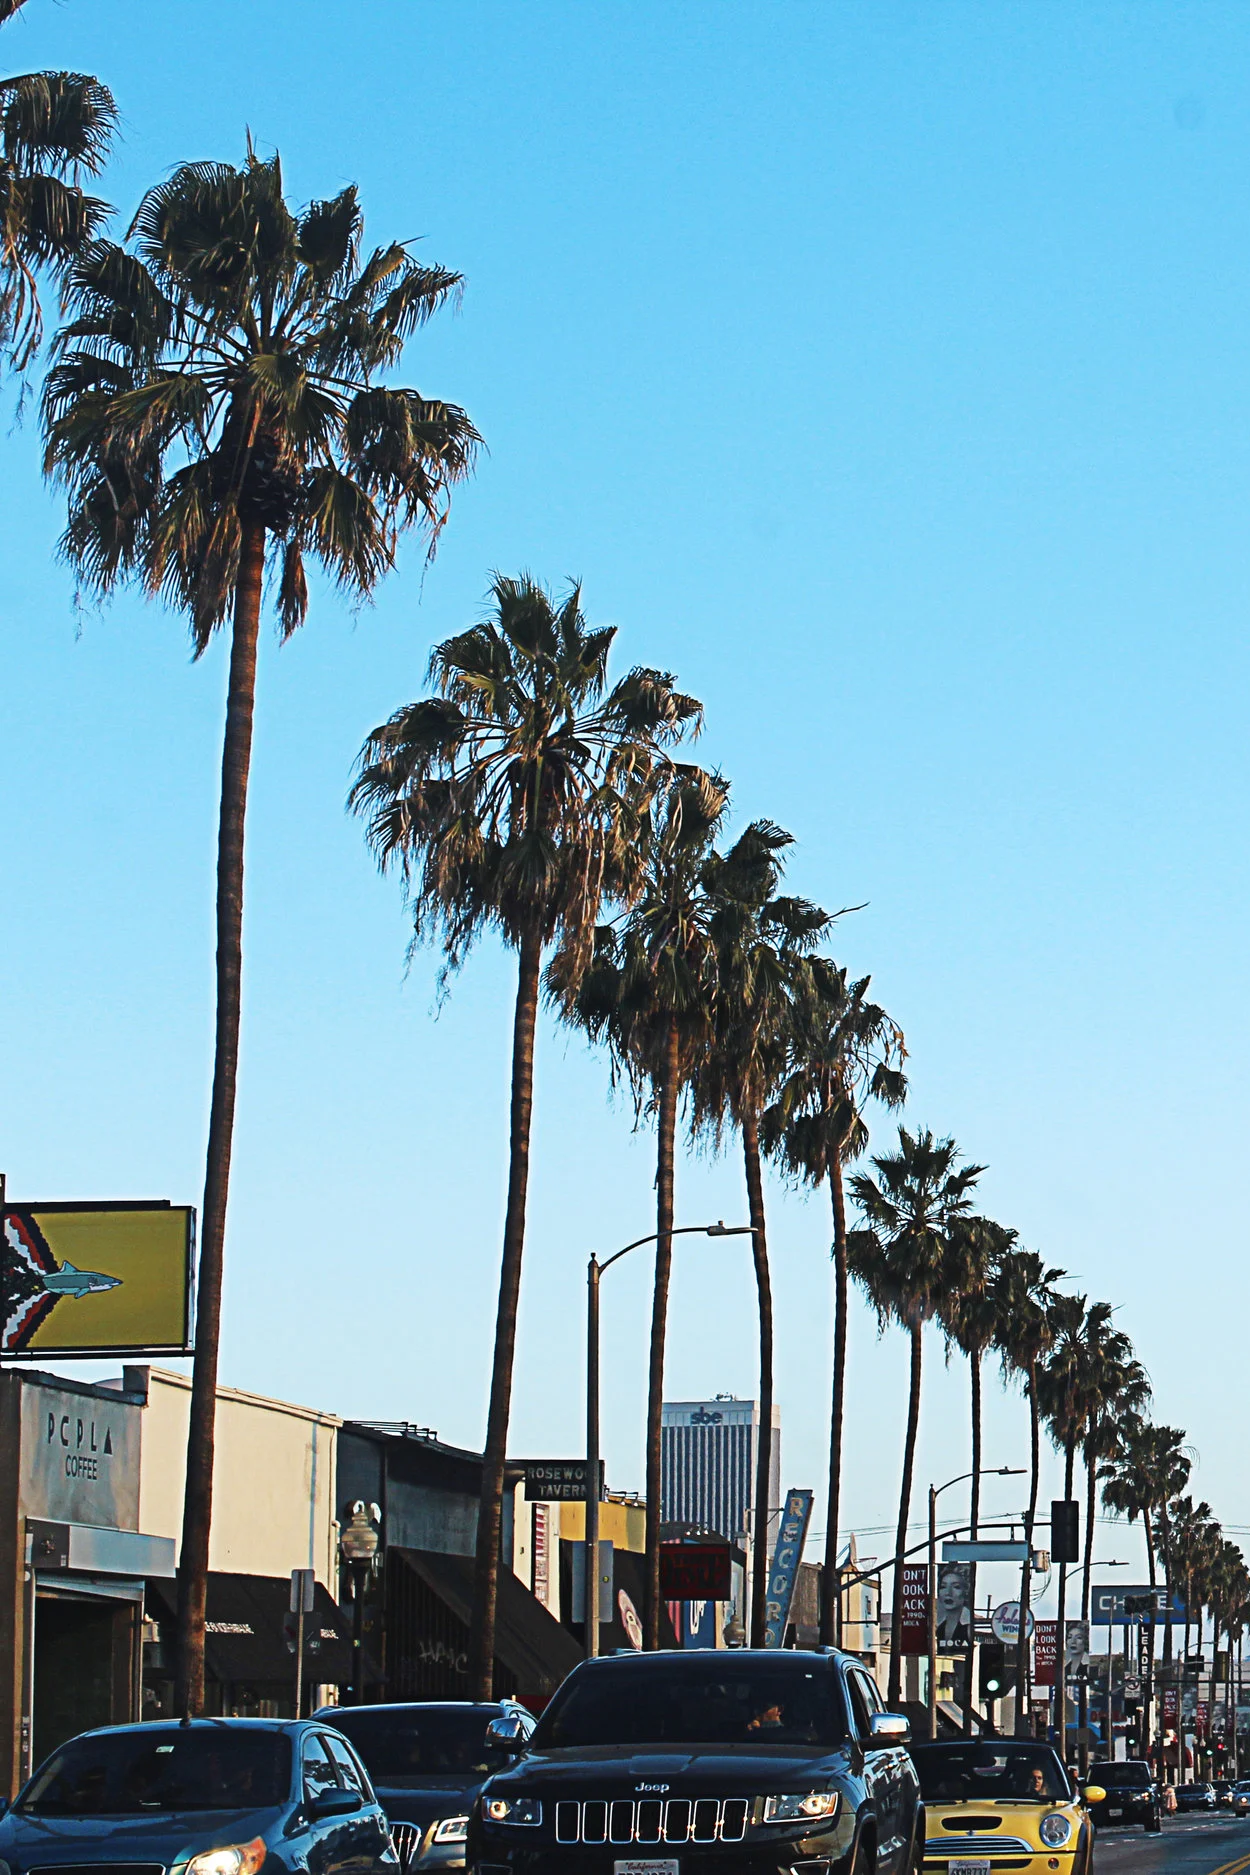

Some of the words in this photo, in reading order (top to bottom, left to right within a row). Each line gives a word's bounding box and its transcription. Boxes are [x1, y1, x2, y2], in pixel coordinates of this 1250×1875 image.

[690, 1406, 723, 1425] sbe
[65, 1454, 97, 1480] COFFEE
[528, 1467, 588, 1480] ROSEWO
[903, 1569, 926, 1580] ON'T
[903, 1585, 925, 1596] OOK
[903, 1599, 925, 1610] ACK
[1099, 1594, 1167, 1611] CHE
[1036, 1625, 1057, 1633] DON'T
[1036, 1635, 1057, 1644] LOOK
[1036, 1645, 1057, 1654] BACK
[634, 1782, 670, 1793] Jeep
